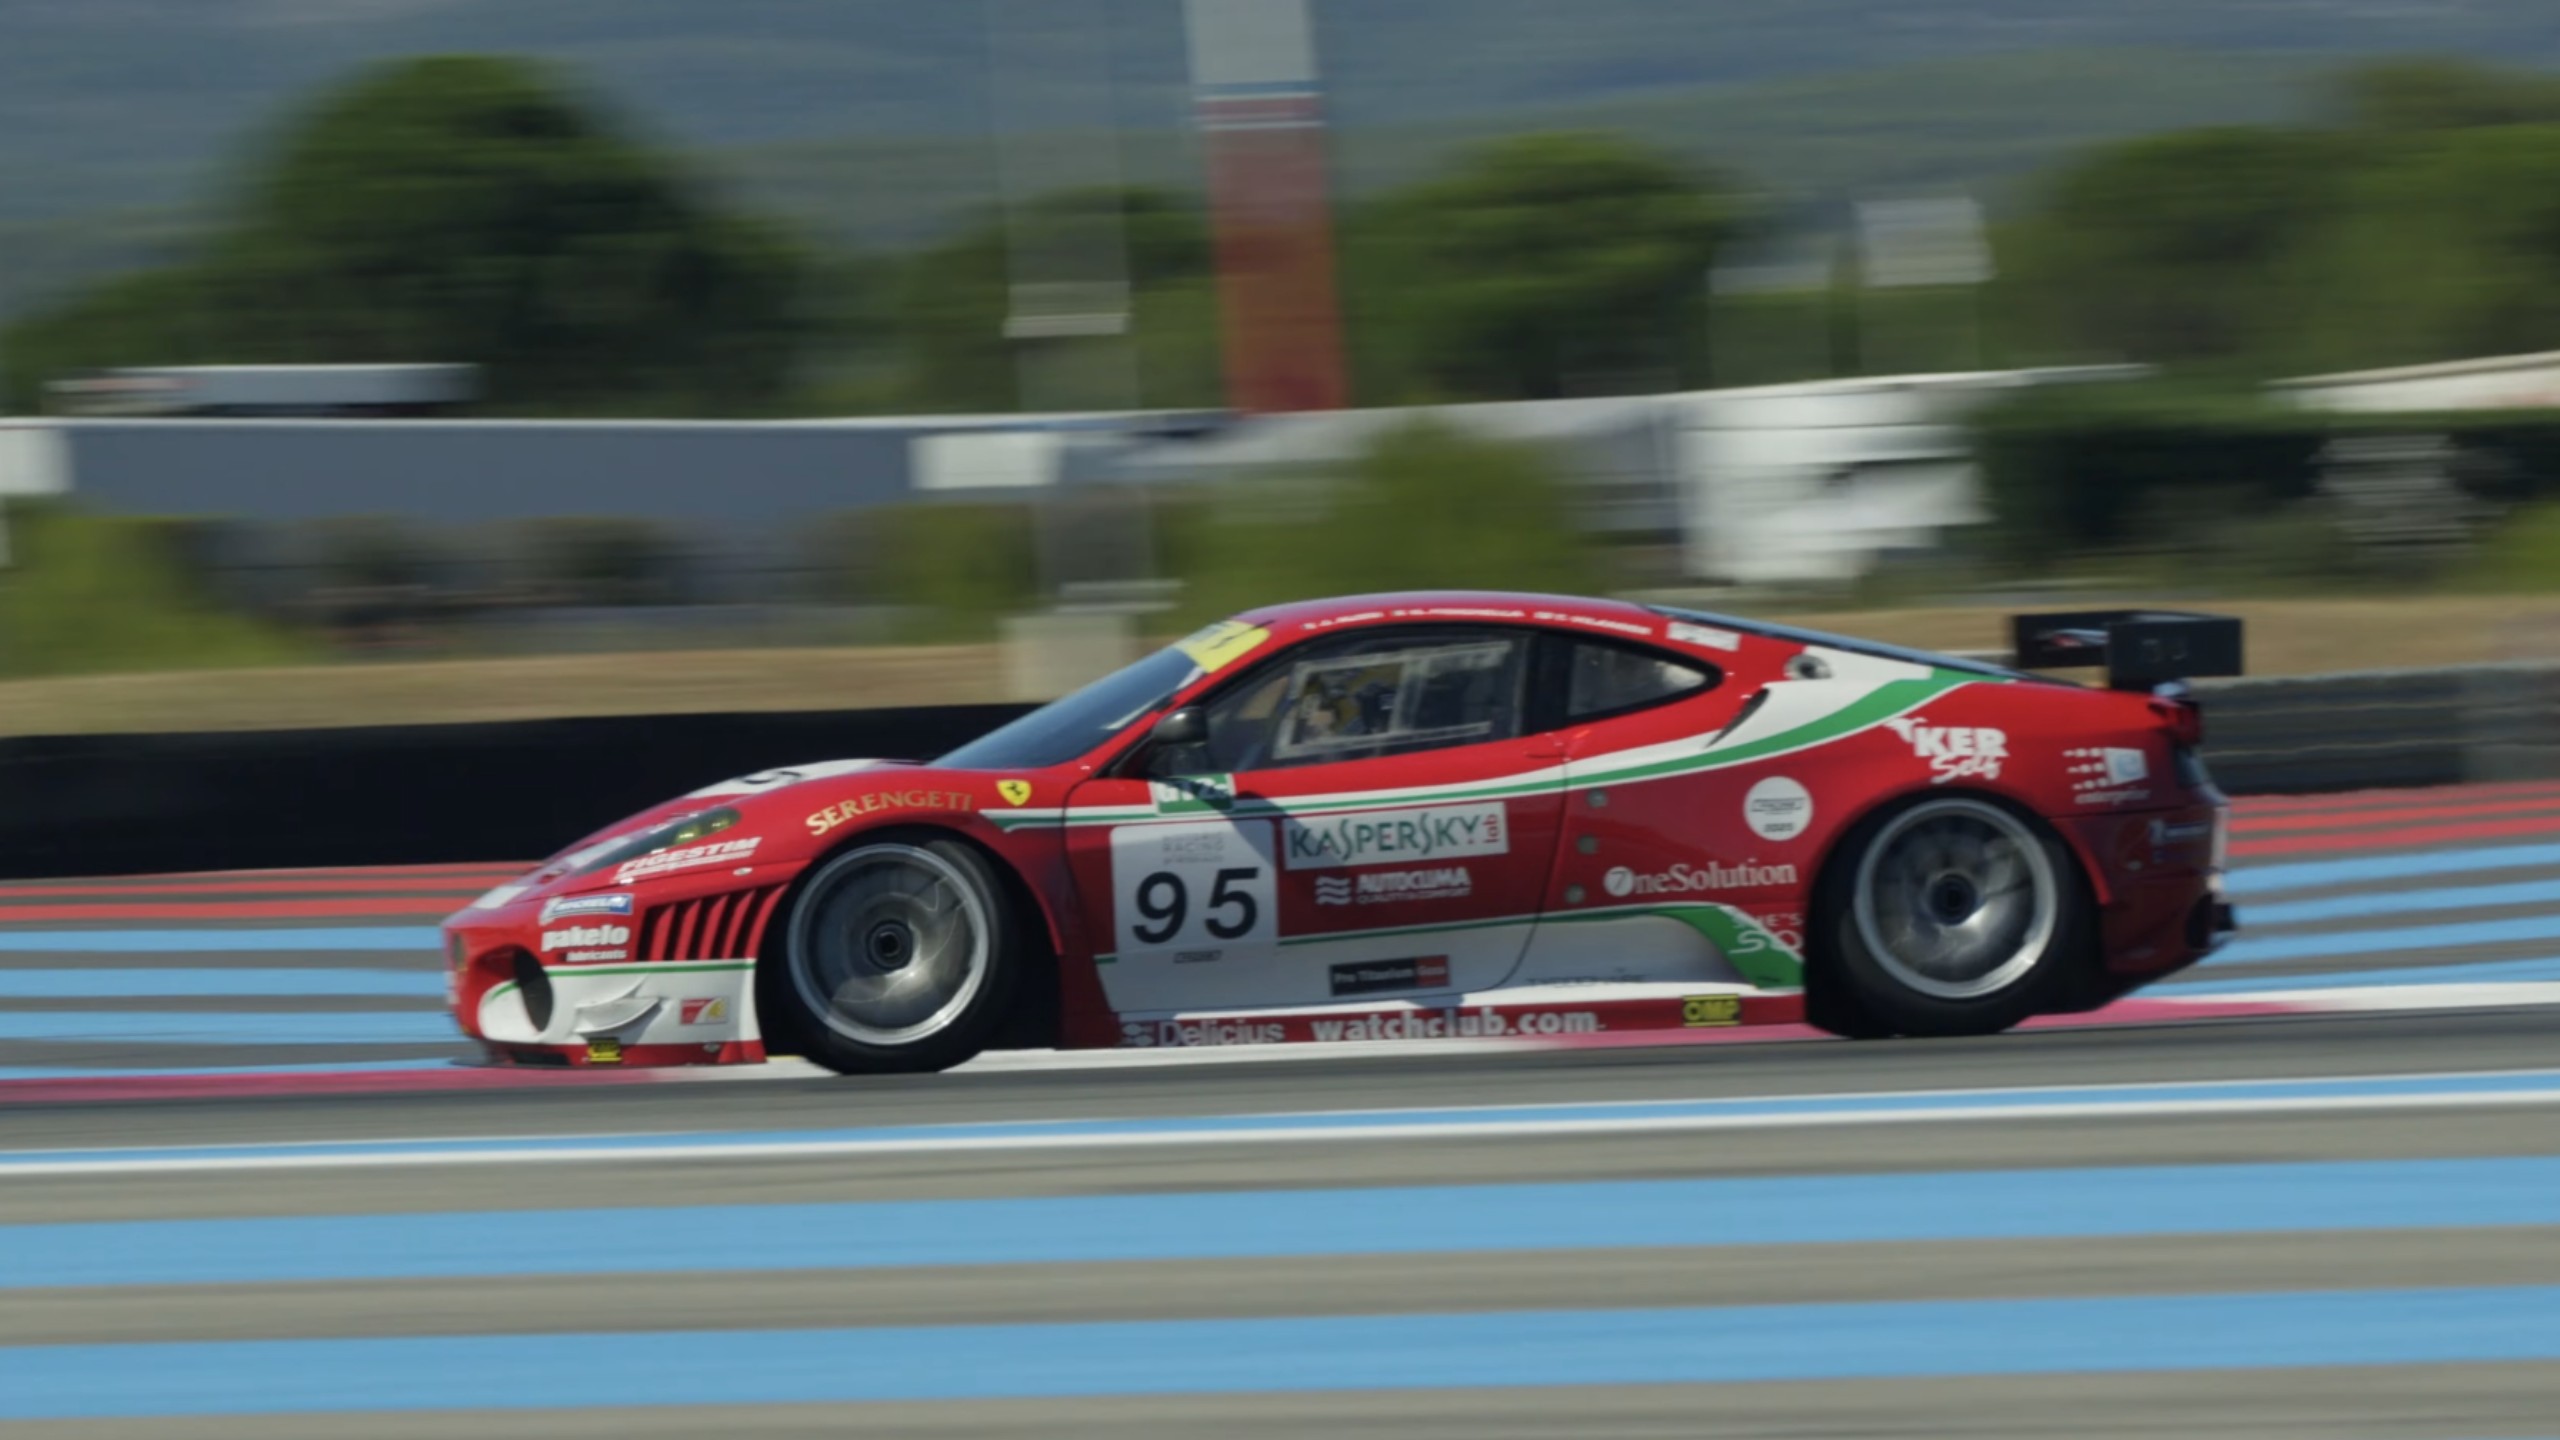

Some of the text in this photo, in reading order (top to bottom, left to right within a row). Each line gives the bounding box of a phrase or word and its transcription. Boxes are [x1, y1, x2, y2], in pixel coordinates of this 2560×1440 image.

[805, 790, 973, 836] SERENGETI
[1288, 813, 1481, 862] KASPERSKY
[1132, 867, 1260, 944] 95
[541, 925, 631, 952] pakelo
[1311, 1006, 1598, 1042] watchclub.com
